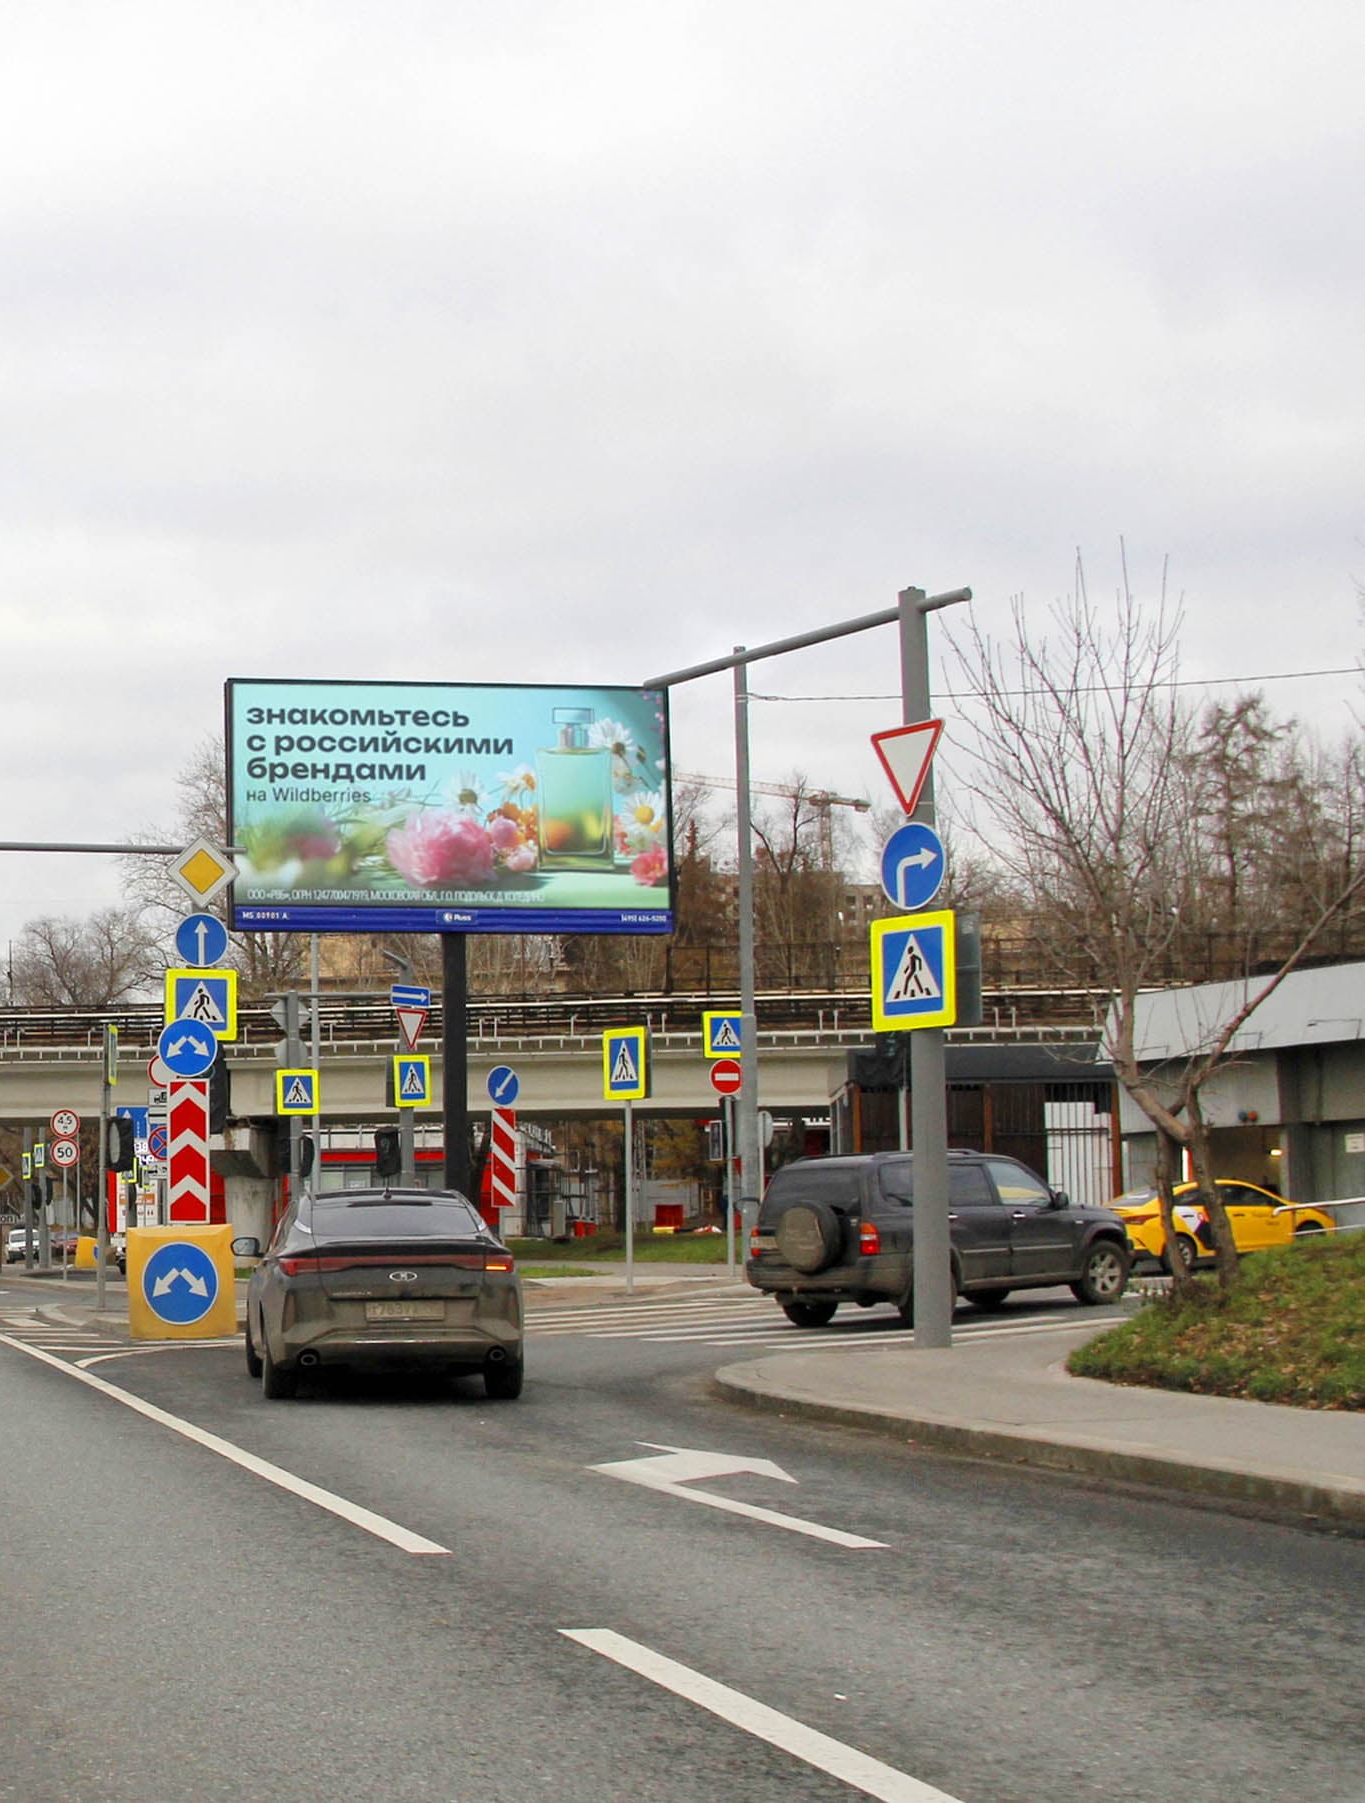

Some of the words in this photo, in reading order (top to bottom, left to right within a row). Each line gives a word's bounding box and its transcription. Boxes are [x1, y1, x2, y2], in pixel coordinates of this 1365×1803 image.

[246, 706, 470, 728] знакомьтесь
[246, 734, 266, 752] с
[274, 730, 514, 756] российскими
[246, 756, 426, 783] брендами
[246, 789, 267, 802] на
[273, 786, 372, 803] Wildberries
[56, 1147, 74, 1159] 50
